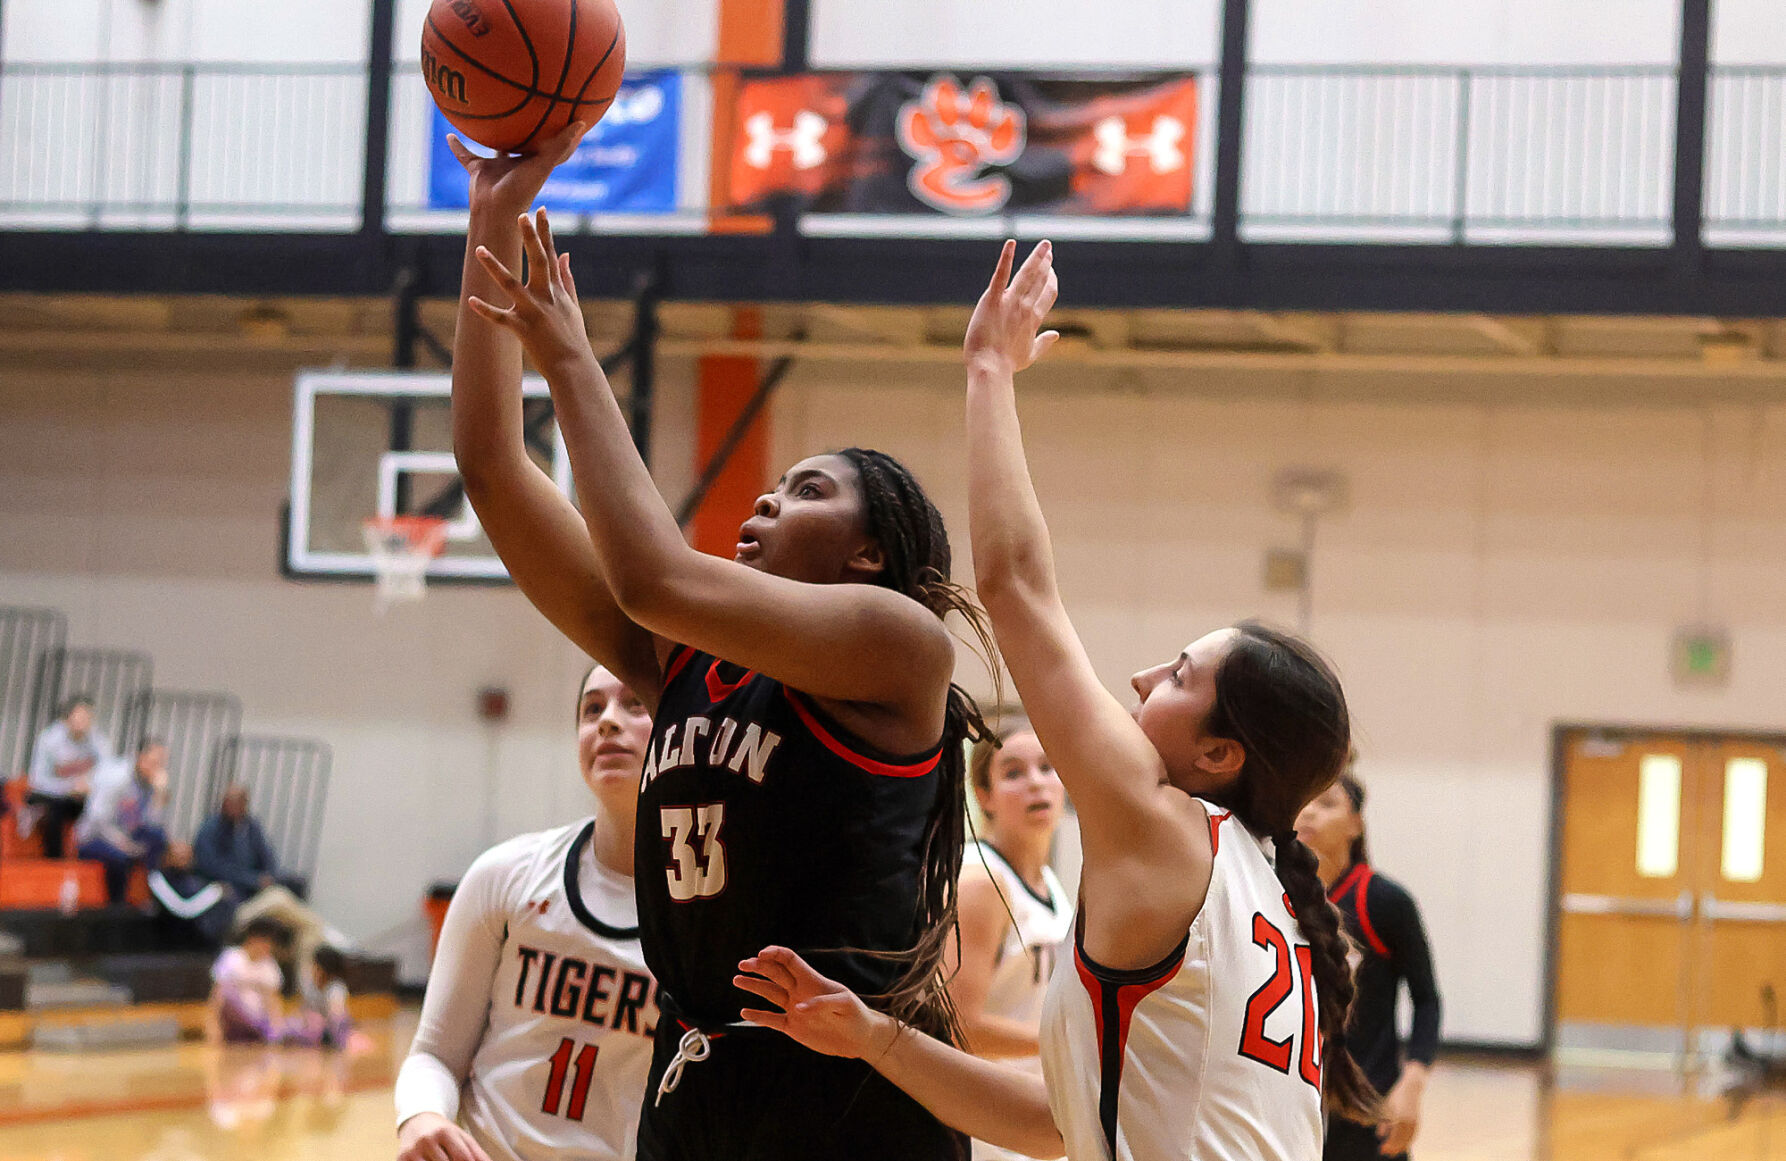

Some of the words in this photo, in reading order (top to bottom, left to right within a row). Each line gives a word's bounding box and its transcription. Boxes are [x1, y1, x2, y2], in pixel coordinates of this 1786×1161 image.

[640, 716, 782, 793] ALTON
[660, 801, 728, 903] 33
[542, 1037, 600, 1122] 11
